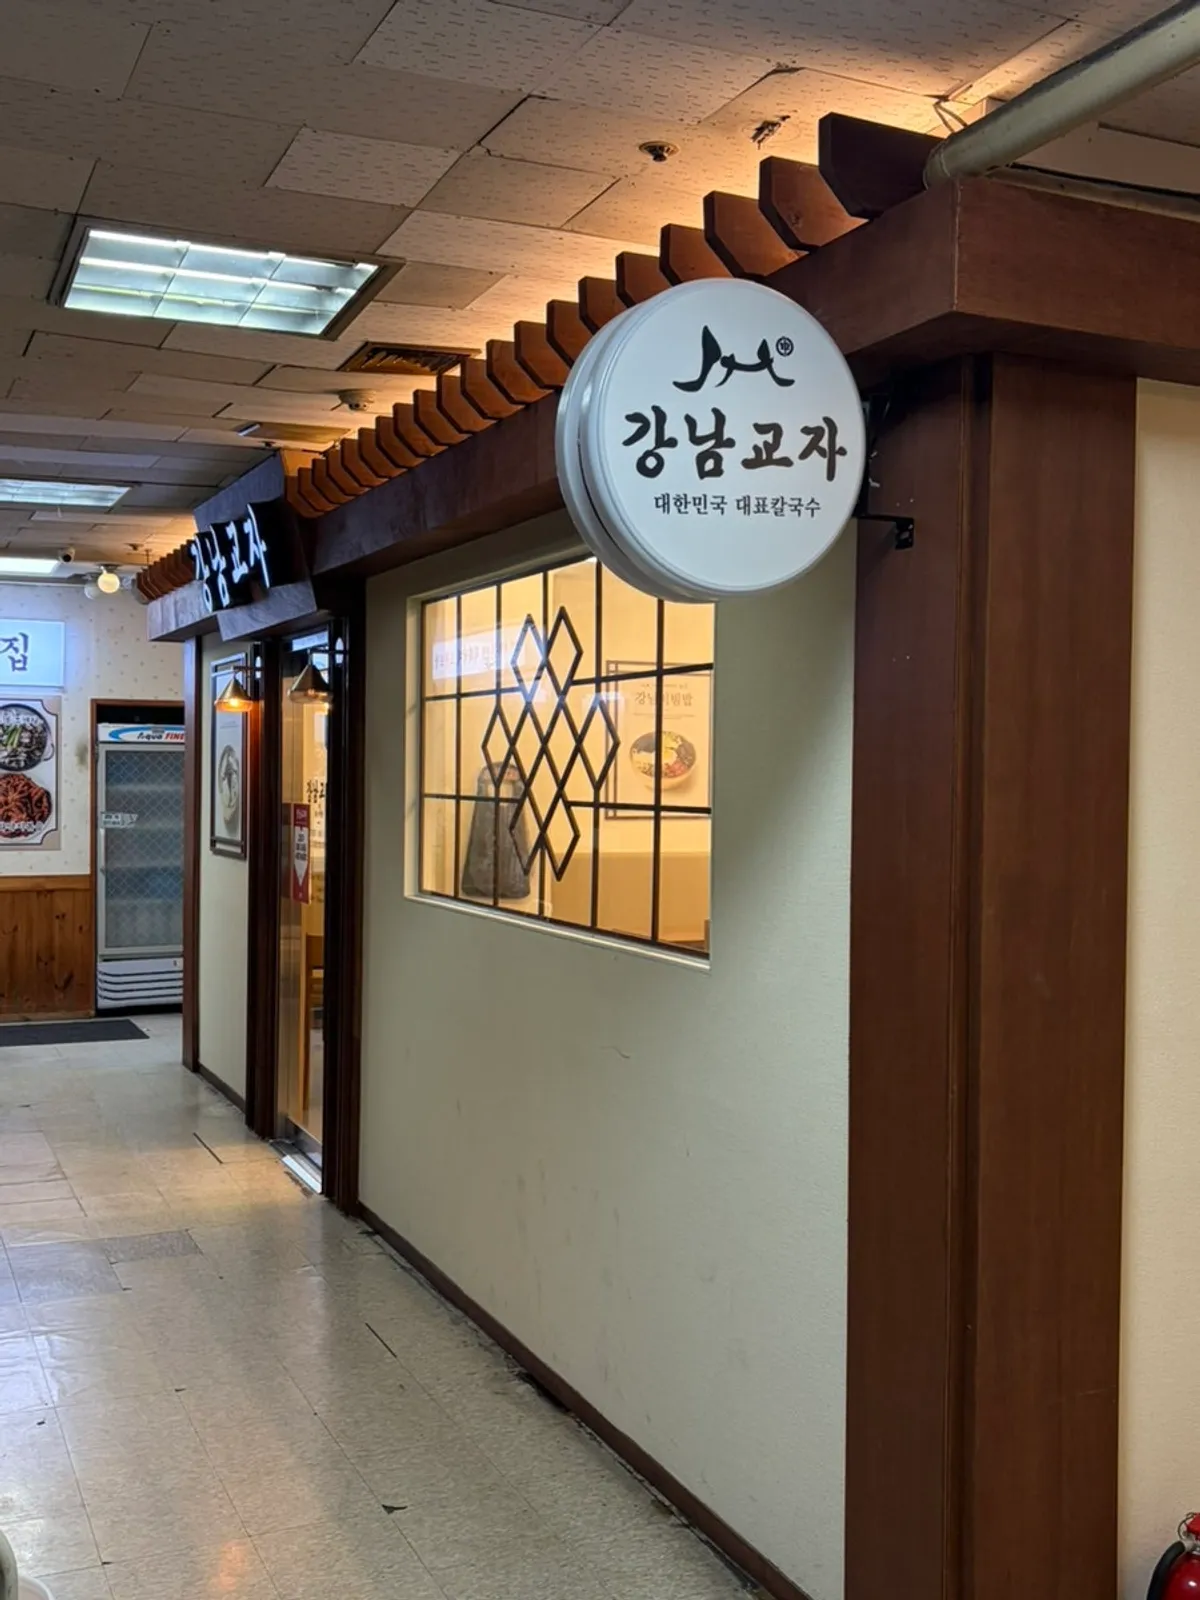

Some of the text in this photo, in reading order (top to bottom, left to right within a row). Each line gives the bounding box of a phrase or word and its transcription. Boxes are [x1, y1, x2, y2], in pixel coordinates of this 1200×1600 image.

[622, 405, 848, 482] 강남교자
[654, 493, 822, 519] 대한민국 대표칼국수
[190, 503, 270, 614] 강남교자
